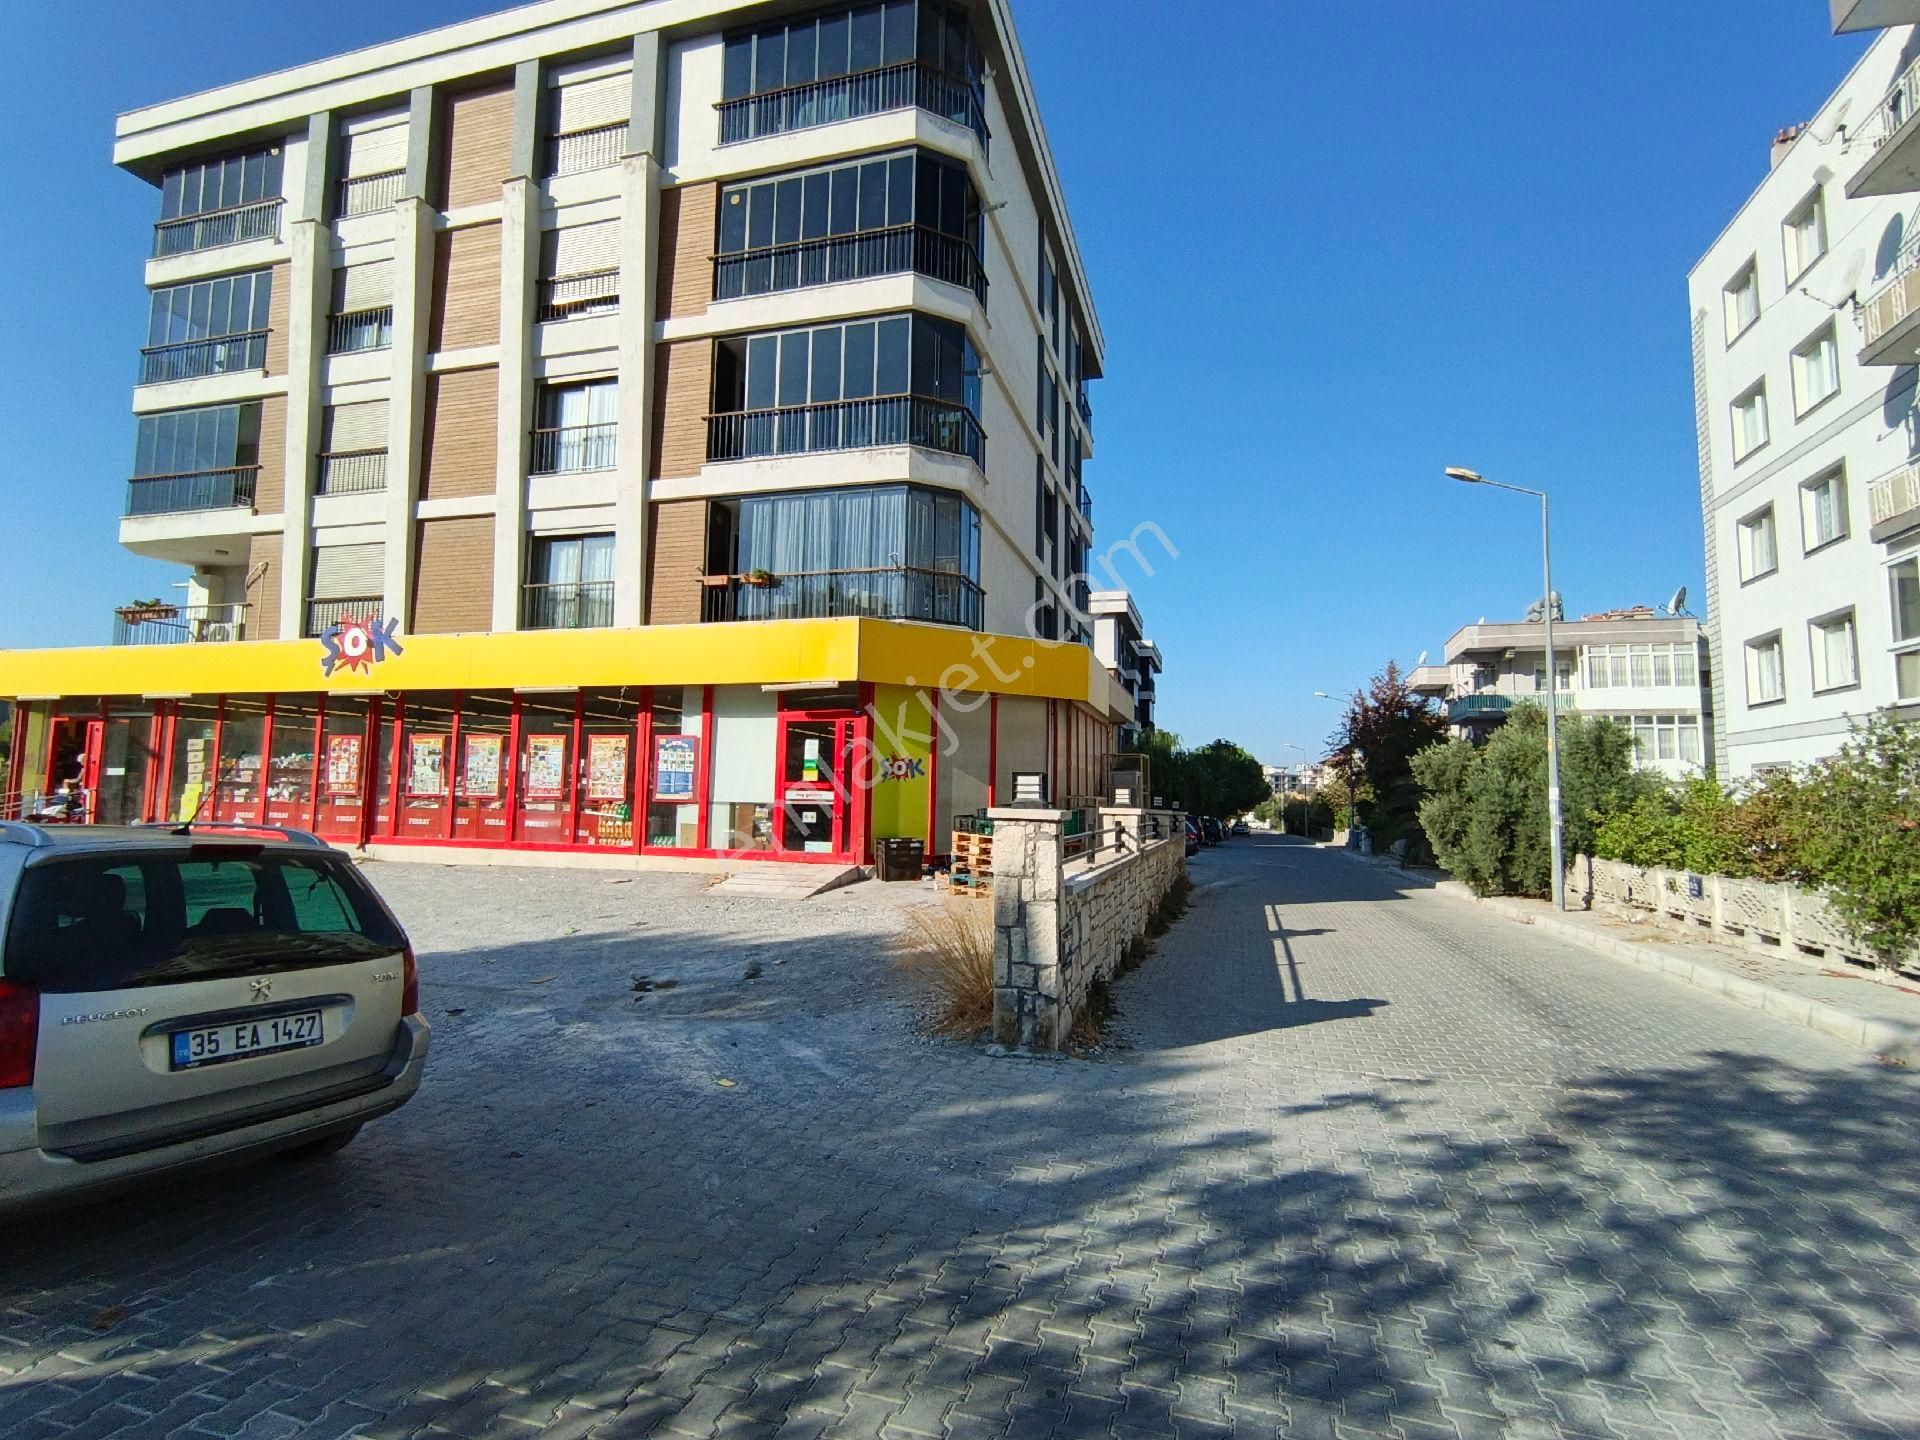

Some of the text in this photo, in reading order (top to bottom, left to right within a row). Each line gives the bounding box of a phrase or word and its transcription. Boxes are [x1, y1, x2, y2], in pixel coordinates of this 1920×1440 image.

[191, 1031, 219, 1057] 35
[235, 1024, 261, 1050] EA
[271, 1015, 317, 1043] 1427
